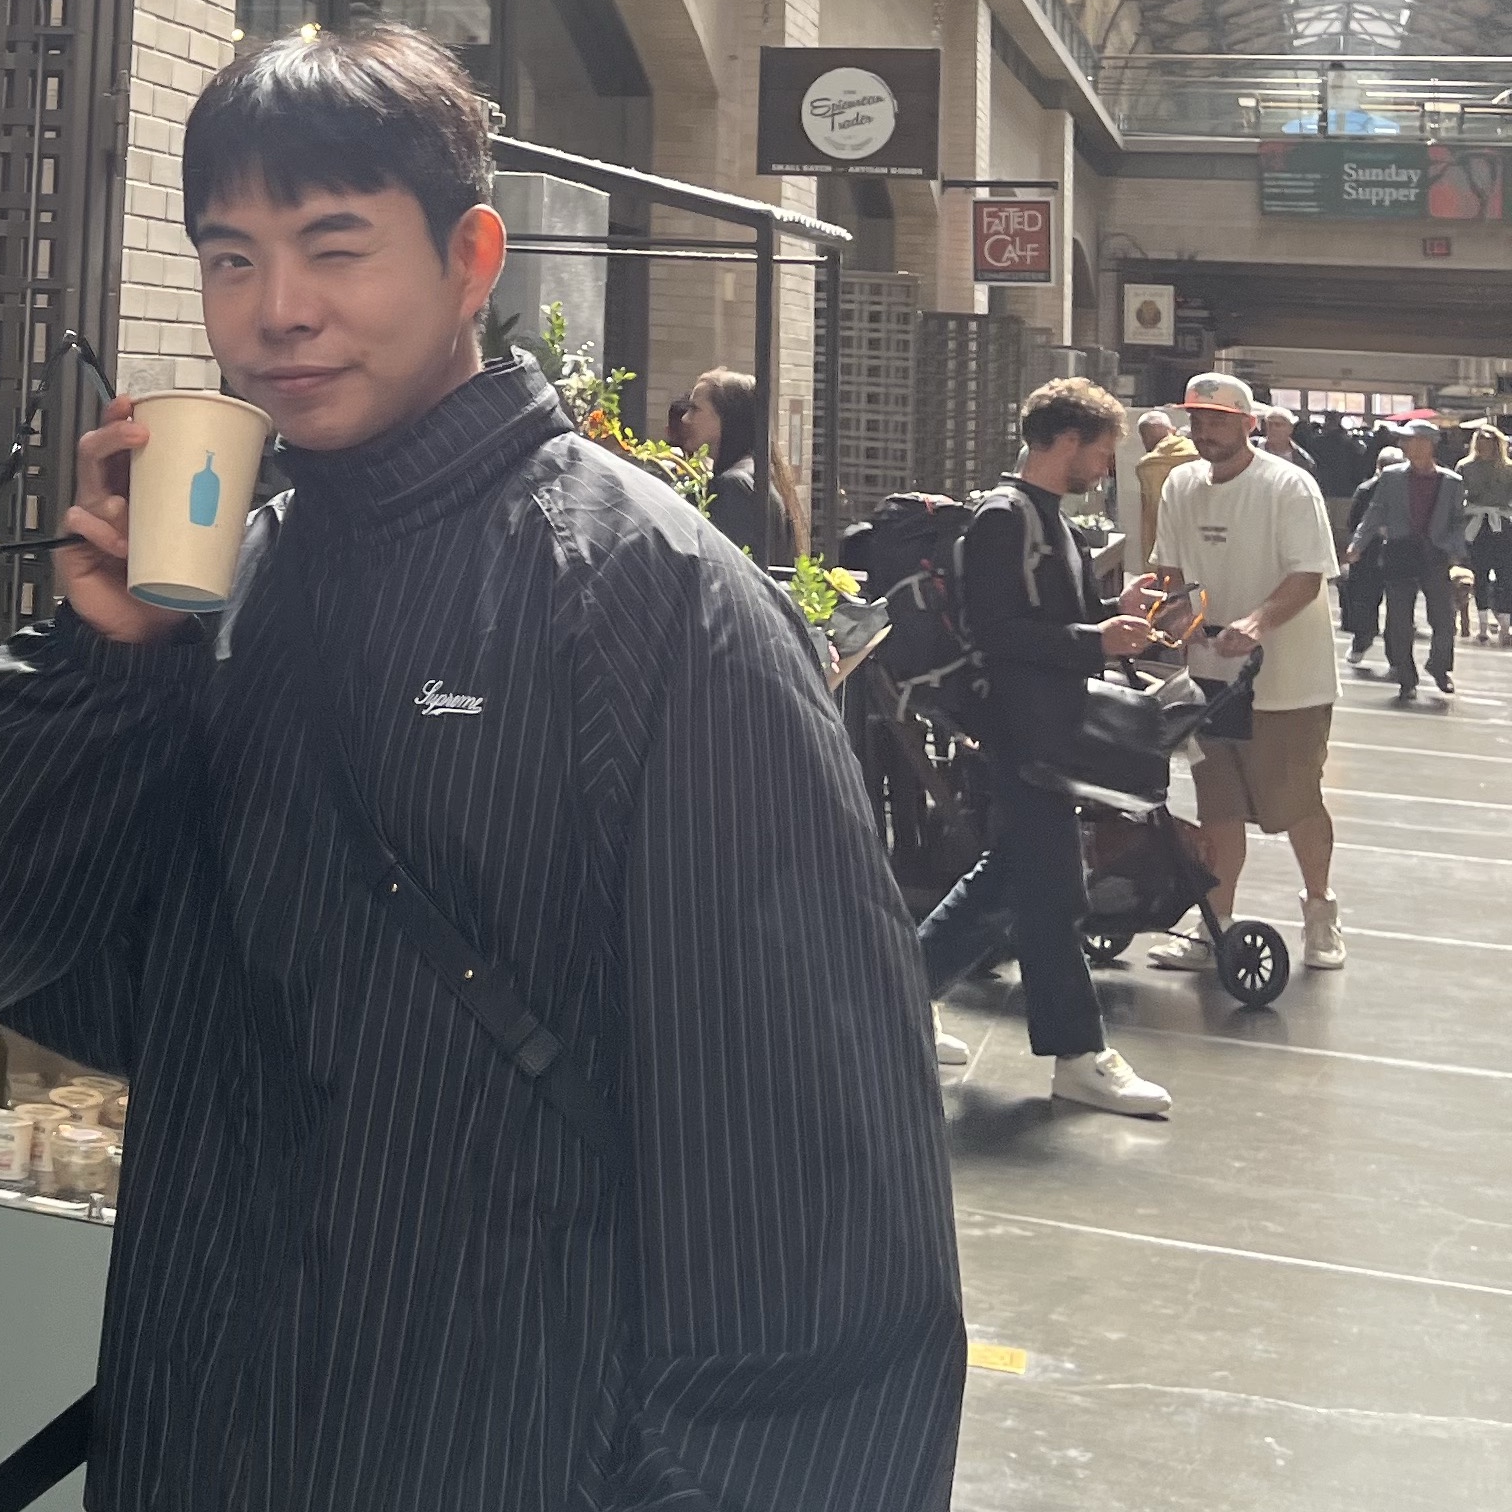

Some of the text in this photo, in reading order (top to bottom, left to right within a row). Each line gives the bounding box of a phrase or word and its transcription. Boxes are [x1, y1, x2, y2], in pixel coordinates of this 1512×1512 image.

[821, 111, 874, 132] Trader
[1343, 162, 1421, 186] Sunday
[1343, 181, 1420, 207] Supper
[983, 207, 1042, 234] FATTED
[984, 234, 1040, 267] CALF
[413, 679, 484, 716] Supreme
